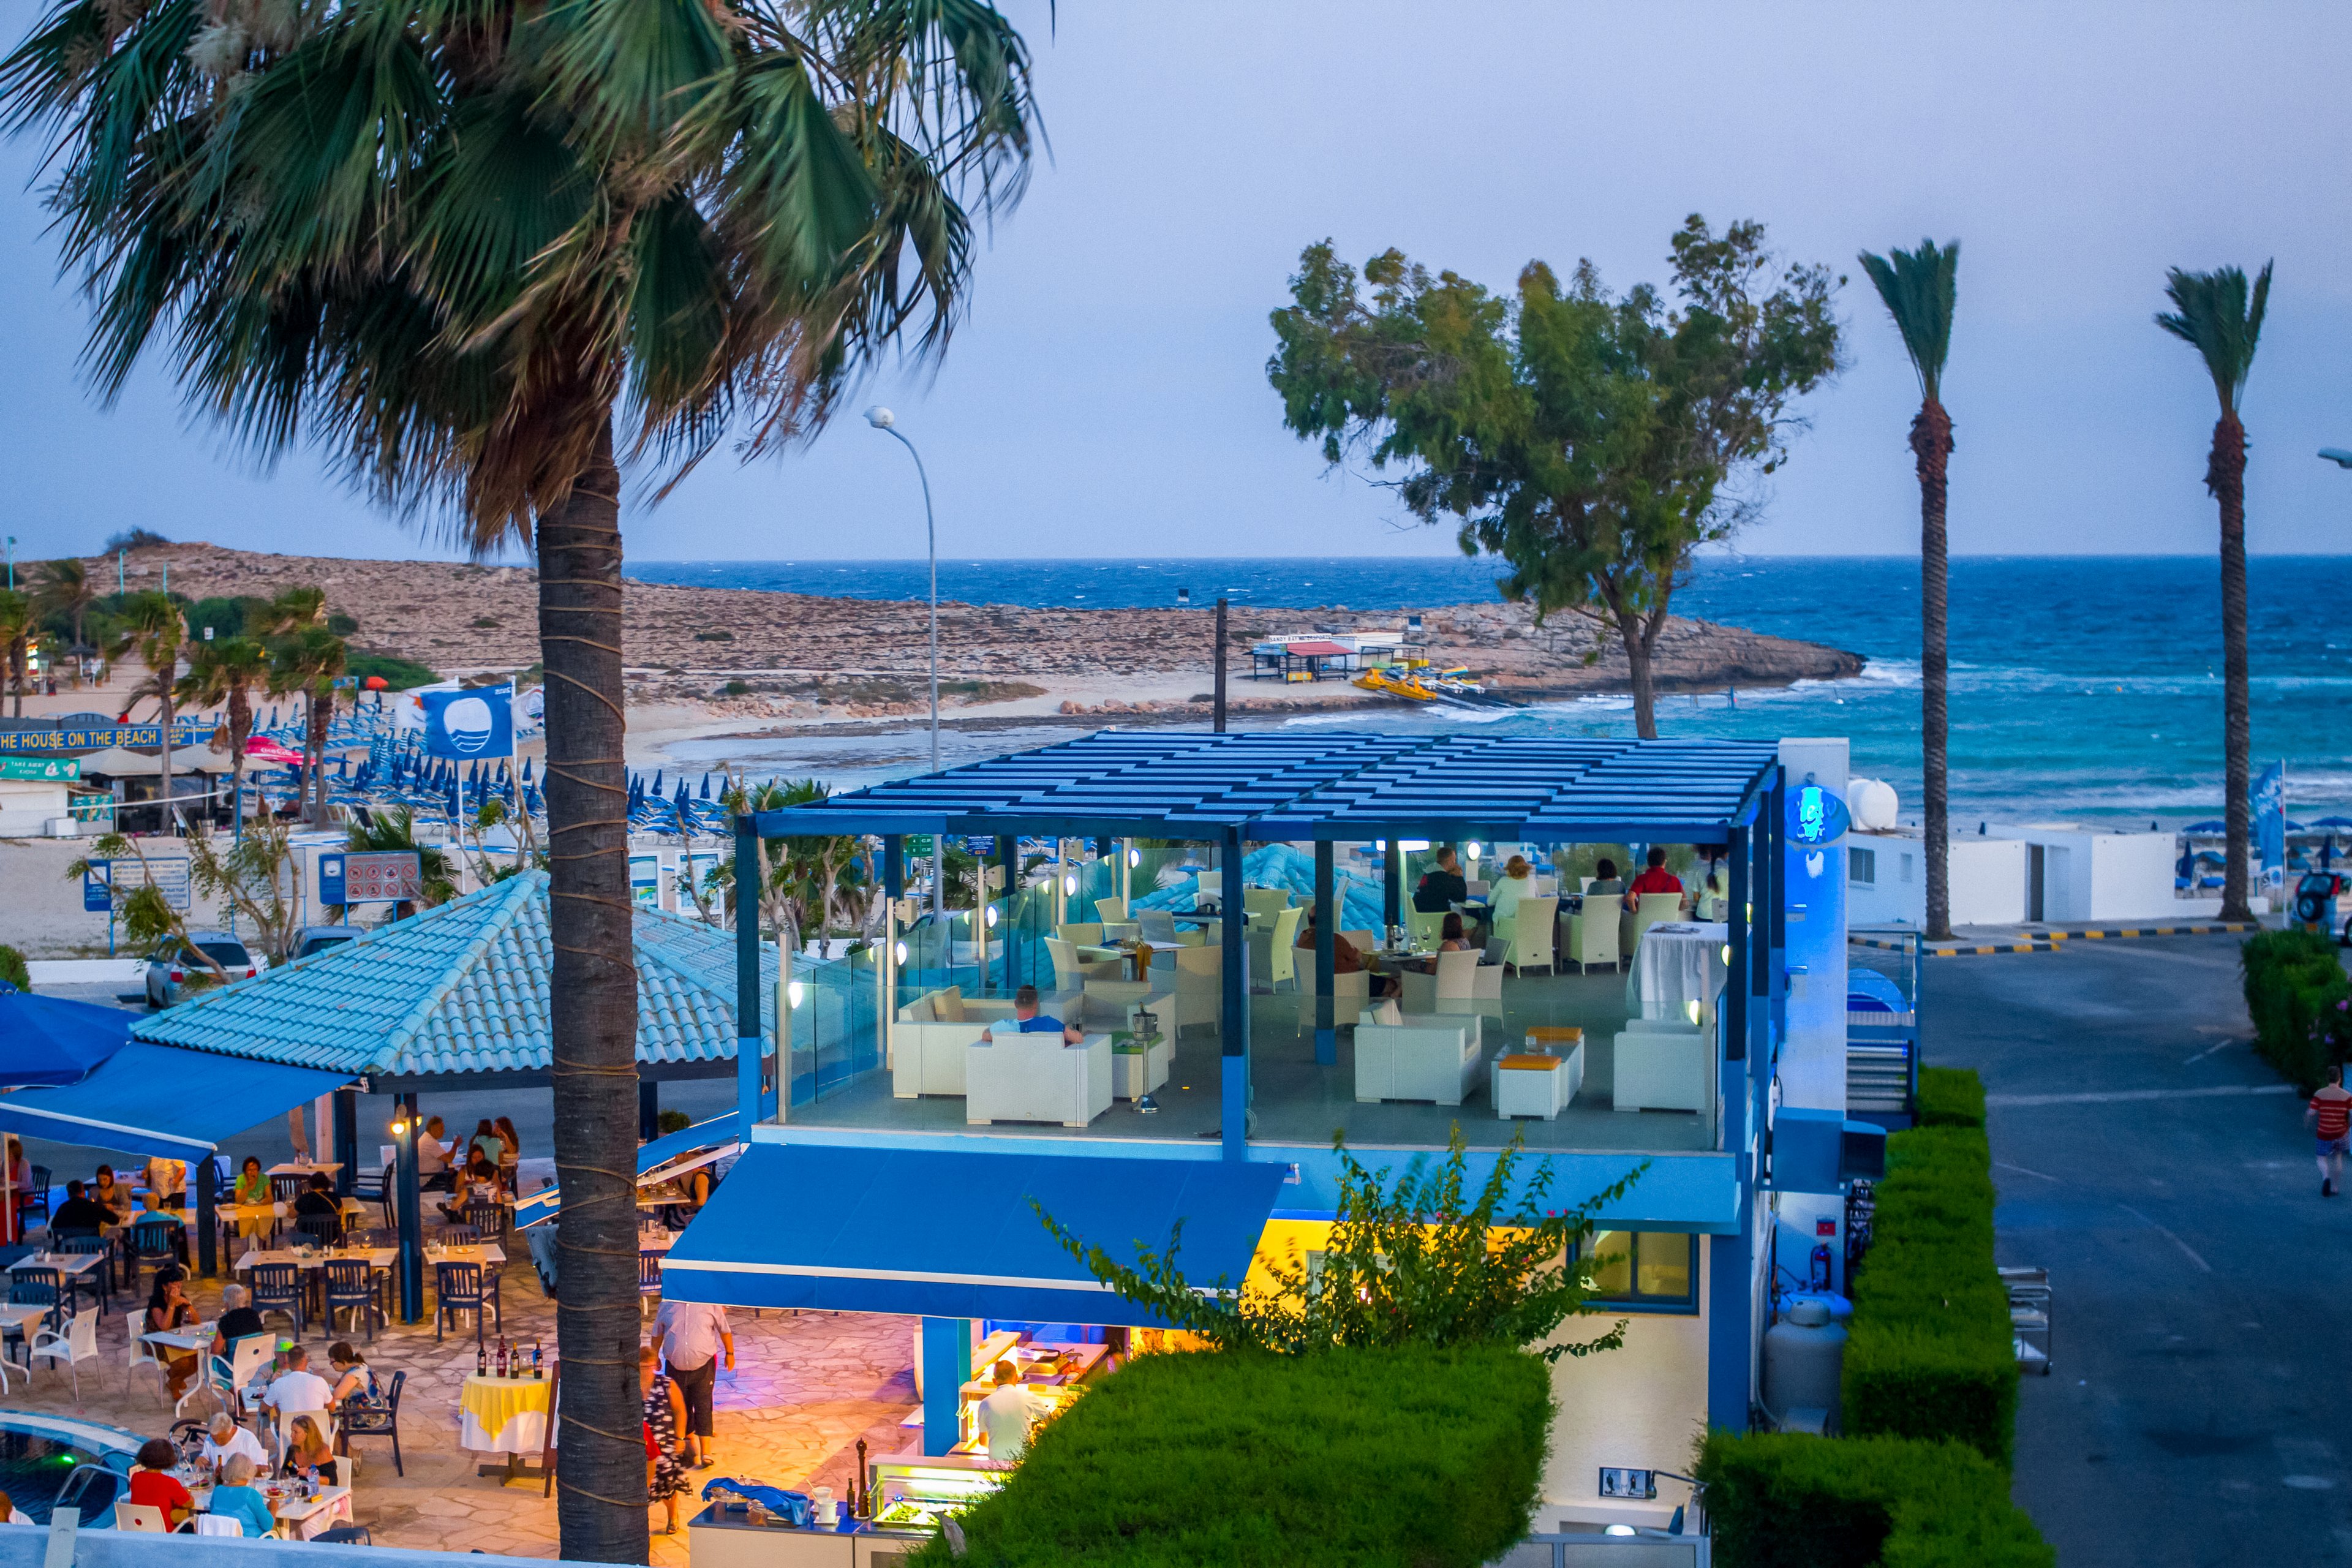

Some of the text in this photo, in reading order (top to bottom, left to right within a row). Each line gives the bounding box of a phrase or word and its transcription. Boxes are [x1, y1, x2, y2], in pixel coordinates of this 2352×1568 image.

[0, 729, 157, 748] HE HOUSE ON THE BEACH
